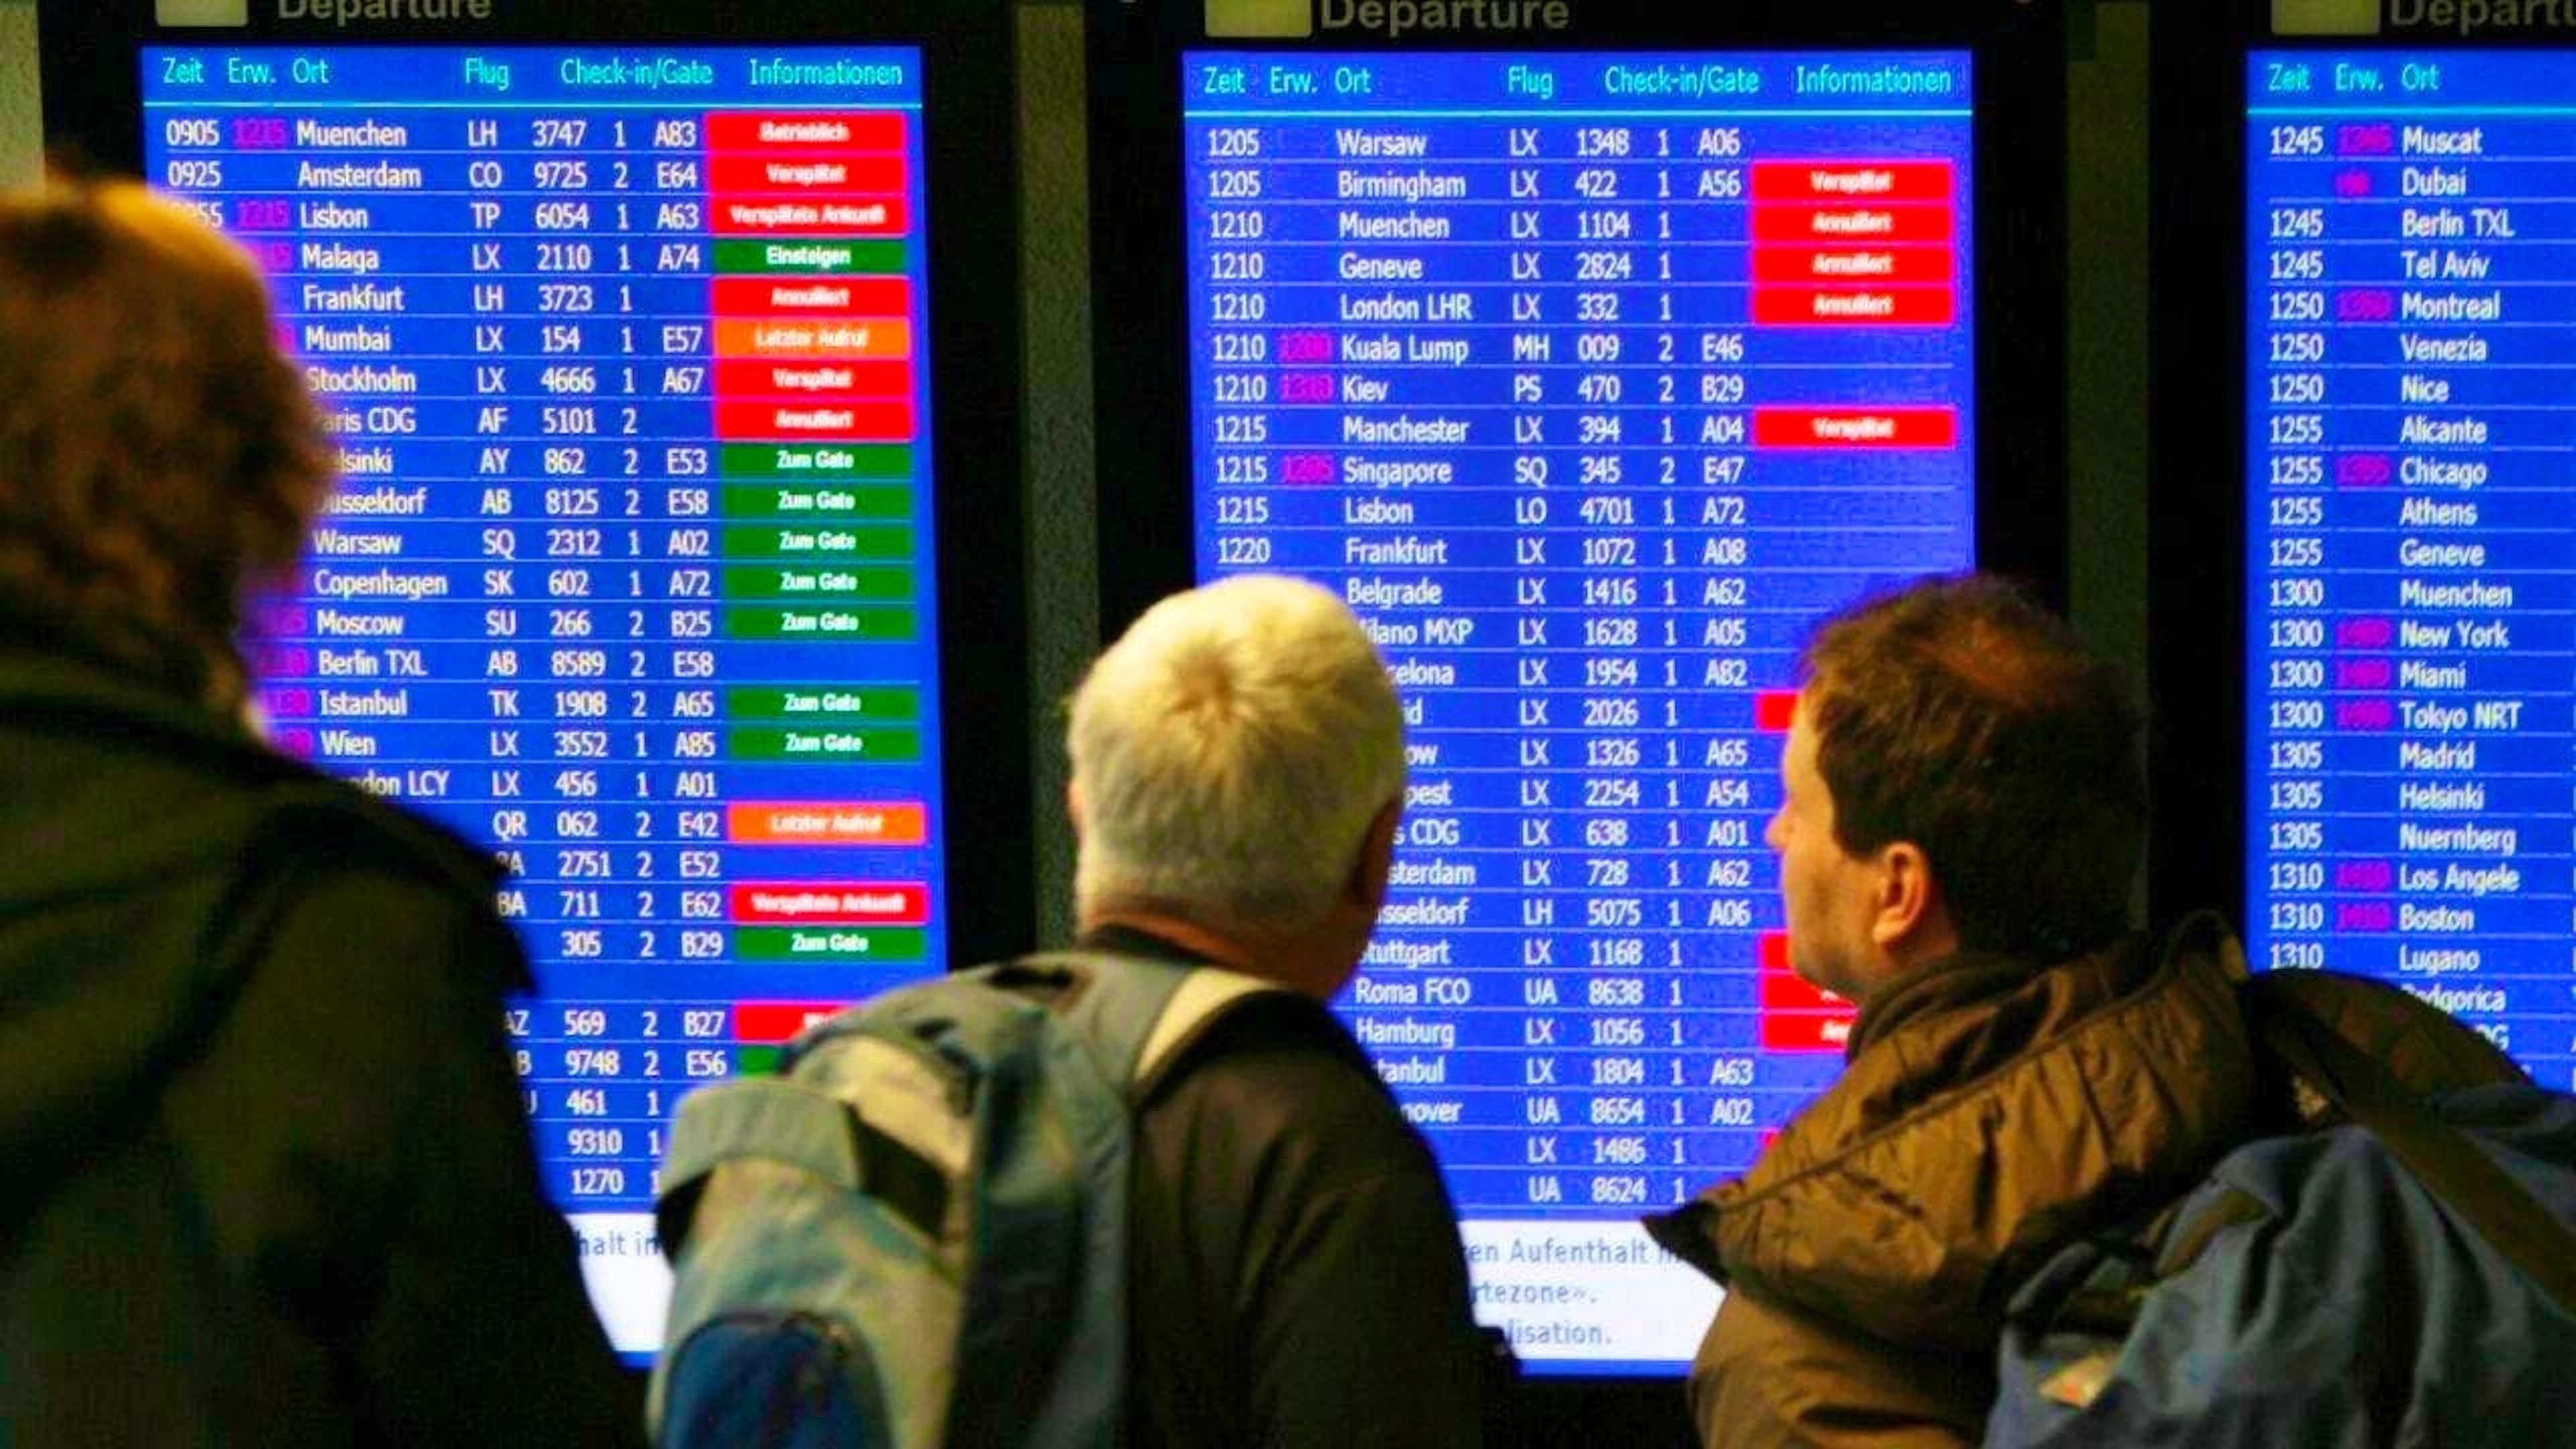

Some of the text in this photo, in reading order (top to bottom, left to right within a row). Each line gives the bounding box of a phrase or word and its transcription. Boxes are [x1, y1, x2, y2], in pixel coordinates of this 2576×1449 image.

[1321, 0, 1570, 38] Departure
[162, 57, 903, 91] Zeit Erw. Ort Flug Check-in/Gate Informationen
[1204, 65, 1953, 99] Zeit Erw. Ort Flug Check-in/Gate Informationen
[2268, 63, 2440, 92] Zeit Erw. Ort
[166, 119, 587, 147] 0905 Muenchen 3747
[1208, 128, 1630, 157] 1205 Warsaw 1348
[2271, 125, 2324, 154] 1245
[2403, 126, 2481, 154] Muscat
[167, 160, 588, 189] 0925 Amsterdam 9725
[1209, 169, 1617, 204] 1205 Birmingham 422
[2402, 167, 2467, 196] Dubai
[300, 201, 590, 229] Lisbon 6054
[1210, 210, 1631, 239] 1210 Muenchen 1104
[2271, 208, 2514, 237] 1245 Berlin TXL
[302, 242, 851, 276] Malaga 2110 Einsteigen
[1211, 251, 1632, 280] 1210 Geneve 2824
[2271, 250, 2489, 279] 1245 Tel Aviv
[303, 282, 593, 312] Frankfurt 3723
[1212, 292, 1619, 321] 1210 London LHR 332
[2271, 291, 2324, 319] 1250
[2402, 292, 2500, 320] Montreal
[305, 324, 582, 352] Mumbai 154
[1213, 333, 1620, 367] 1210 Kuala Lump 009
[2271, 333, 2487, 362] 1250 Venezia
[306, 364, 596, 394] Stockholm 4666
[1214, 374, 1621, 402] 1210 Kiev 470
[2271, 374, 2449, 402] 1250 Nice
[368, 407, 596, 434] CDG 5101
[1215, 415, 1621, 443] 1215 Manchester 394
[2271, 415, 2487, 443] 1255 Alicante
[776, 450, 855, 469] Zum Gate
[1216, 455, 1621, 489] 1215 Singapore 345
[2271, 456, 2323, 484] 1255
[2400, 457, 2487, 489] Chicago
[545, 488, 599, 515] 8125
[1217, 496, 1634, 525] 1215 Lisbon 4701
[2271, 497, 2477, 525] 1255 Athens
[313, 528, 402, 555] Warsaw
[1218, 535, 1636, 566] 1220 Frankfurt 1072
[2271, 538, 2485, 566] 1255 Geneve
[313, 568, 590, 601] Copenhagen 602
[1346, 576, 1638, 610] Belgrade 1416
[2271, 578, 2513, 607] 1300 Muenchen
[316, 608, 592, 637] Moscow 266
[1424, 617, 1638, 646] MXP 1628
[2271, 619, 2324, 647] 1300
[2400, 621, 2451, 647] New
[2457, 621, 2508, 647] York
[318, 649, 427, 676] Berlin TXL
[2271, 660, 2324, 688] 1300
[2400, 661, 2467, 688] Miami
[319, 689, 607, 717] Istanbul 1908
[1584, 698, 1640, 727] 2026
[2271, 701, 2324, 728] 1300
[2399, 701, 2468, 733] Tokyo
[2474, 702, 2522, 728] NRT
[320, 729, 608, 758] Wien 3552
[1587, 739, 1640, 767] 1326
[2271, 741, 2475, 769] 1305 Madrid
[408, 769, 597, 797] LCY 456
[2271, 782, 2484, 810] 1305 Helsinki
[2271, 822, 2516, 856] 1305 Nuernberg
[559, 850, 611, 877] 2751
[2271, 862, 2519, 896] 1310 Los Angele
[1587, 898, 1642, 926] 5075
[2271, 902, 2475, 931] 1310 Boston
[2400, 945, 2480, 976] Lugano
[1354, 976, 1471, 1005] Roma FCO
[564, 1009, 606, 1036] 569
[1356, 1016, 1645, 1051] Hamburg 1056
[566, 1049, 621, 1076] 9748
[568, 1128, 623, 1155] 9310
[572, 1167, 625, 1195] 1270
[1509, 1238, 1649, 1263] Aufenthalt
